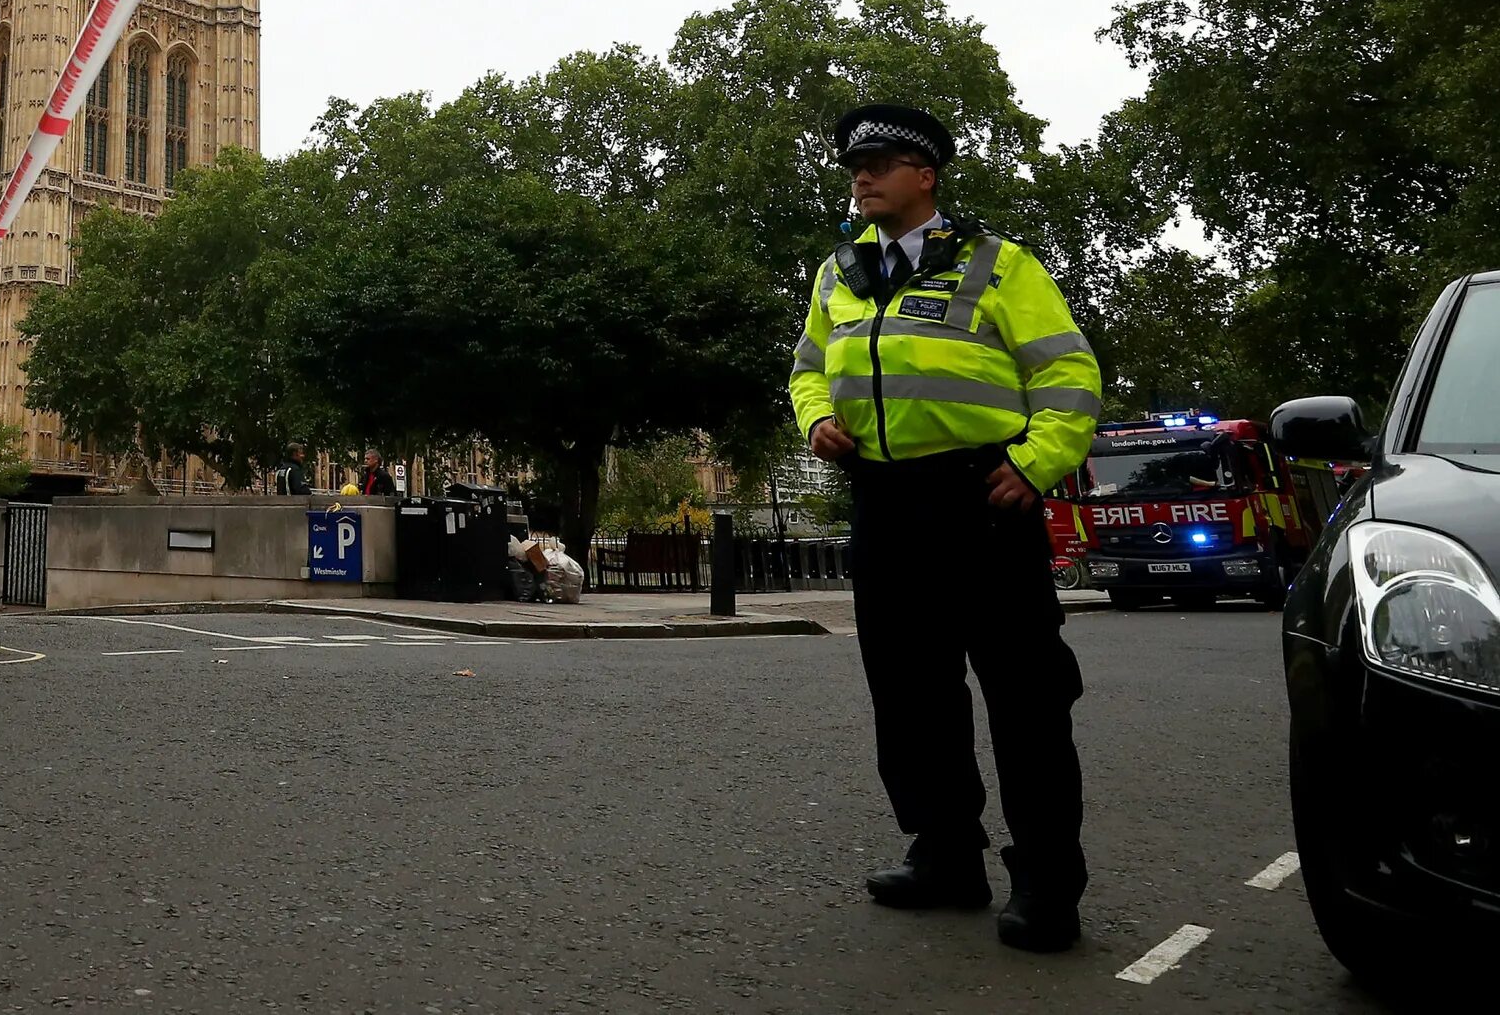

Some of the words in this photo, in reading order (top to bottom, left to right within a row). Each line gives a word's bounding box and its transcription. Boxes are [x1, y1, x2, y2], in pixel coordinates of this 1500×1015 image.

[1111, 437, 1177, 447] london-fire.gov.uk
[1170, 503, 1229, 523] FIRE
[313, 567, 347, 576] Westminster
